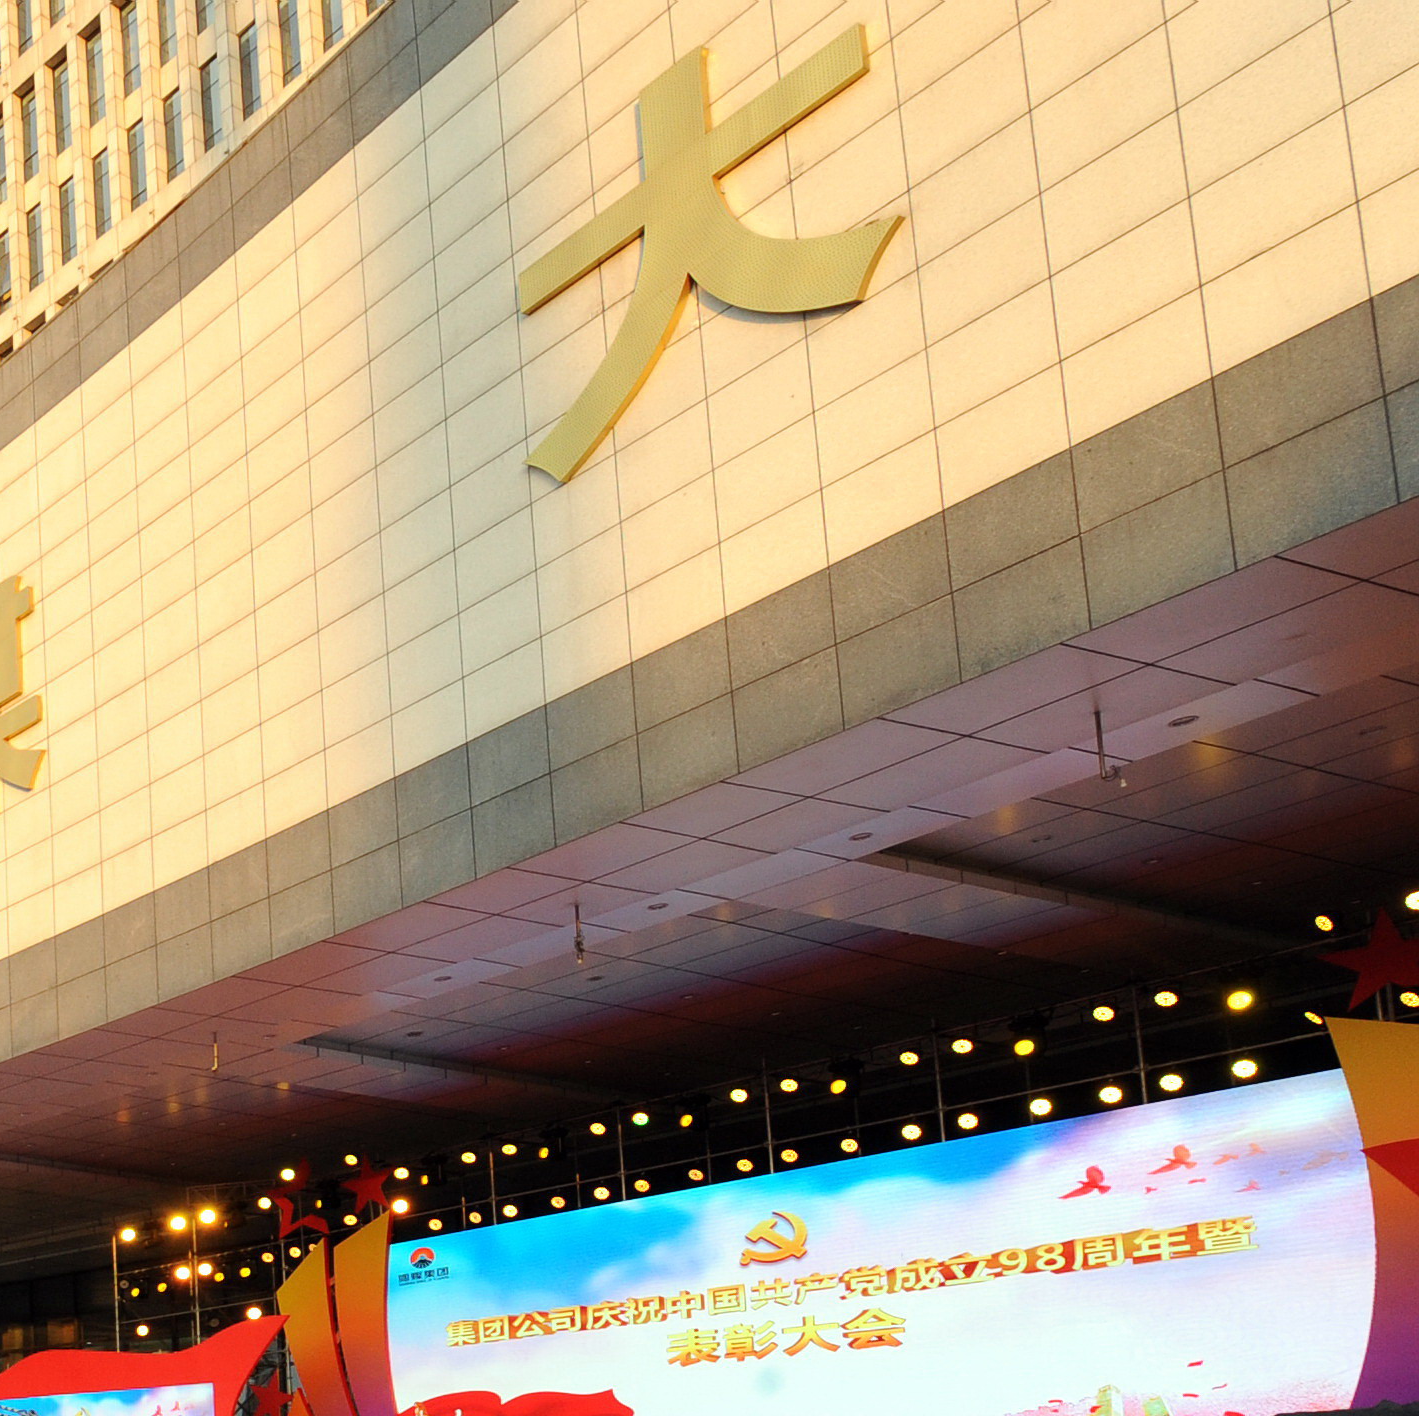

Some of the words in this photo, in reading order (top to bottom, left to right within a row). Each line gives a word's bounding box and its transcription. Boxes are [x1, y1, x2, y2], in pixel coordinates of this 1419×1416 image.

[446, 1215, 1258, 1347] 集团公司庆祝中国共产党成立98周年暨
[667, 1307, 906, 1367] 表彰大会
